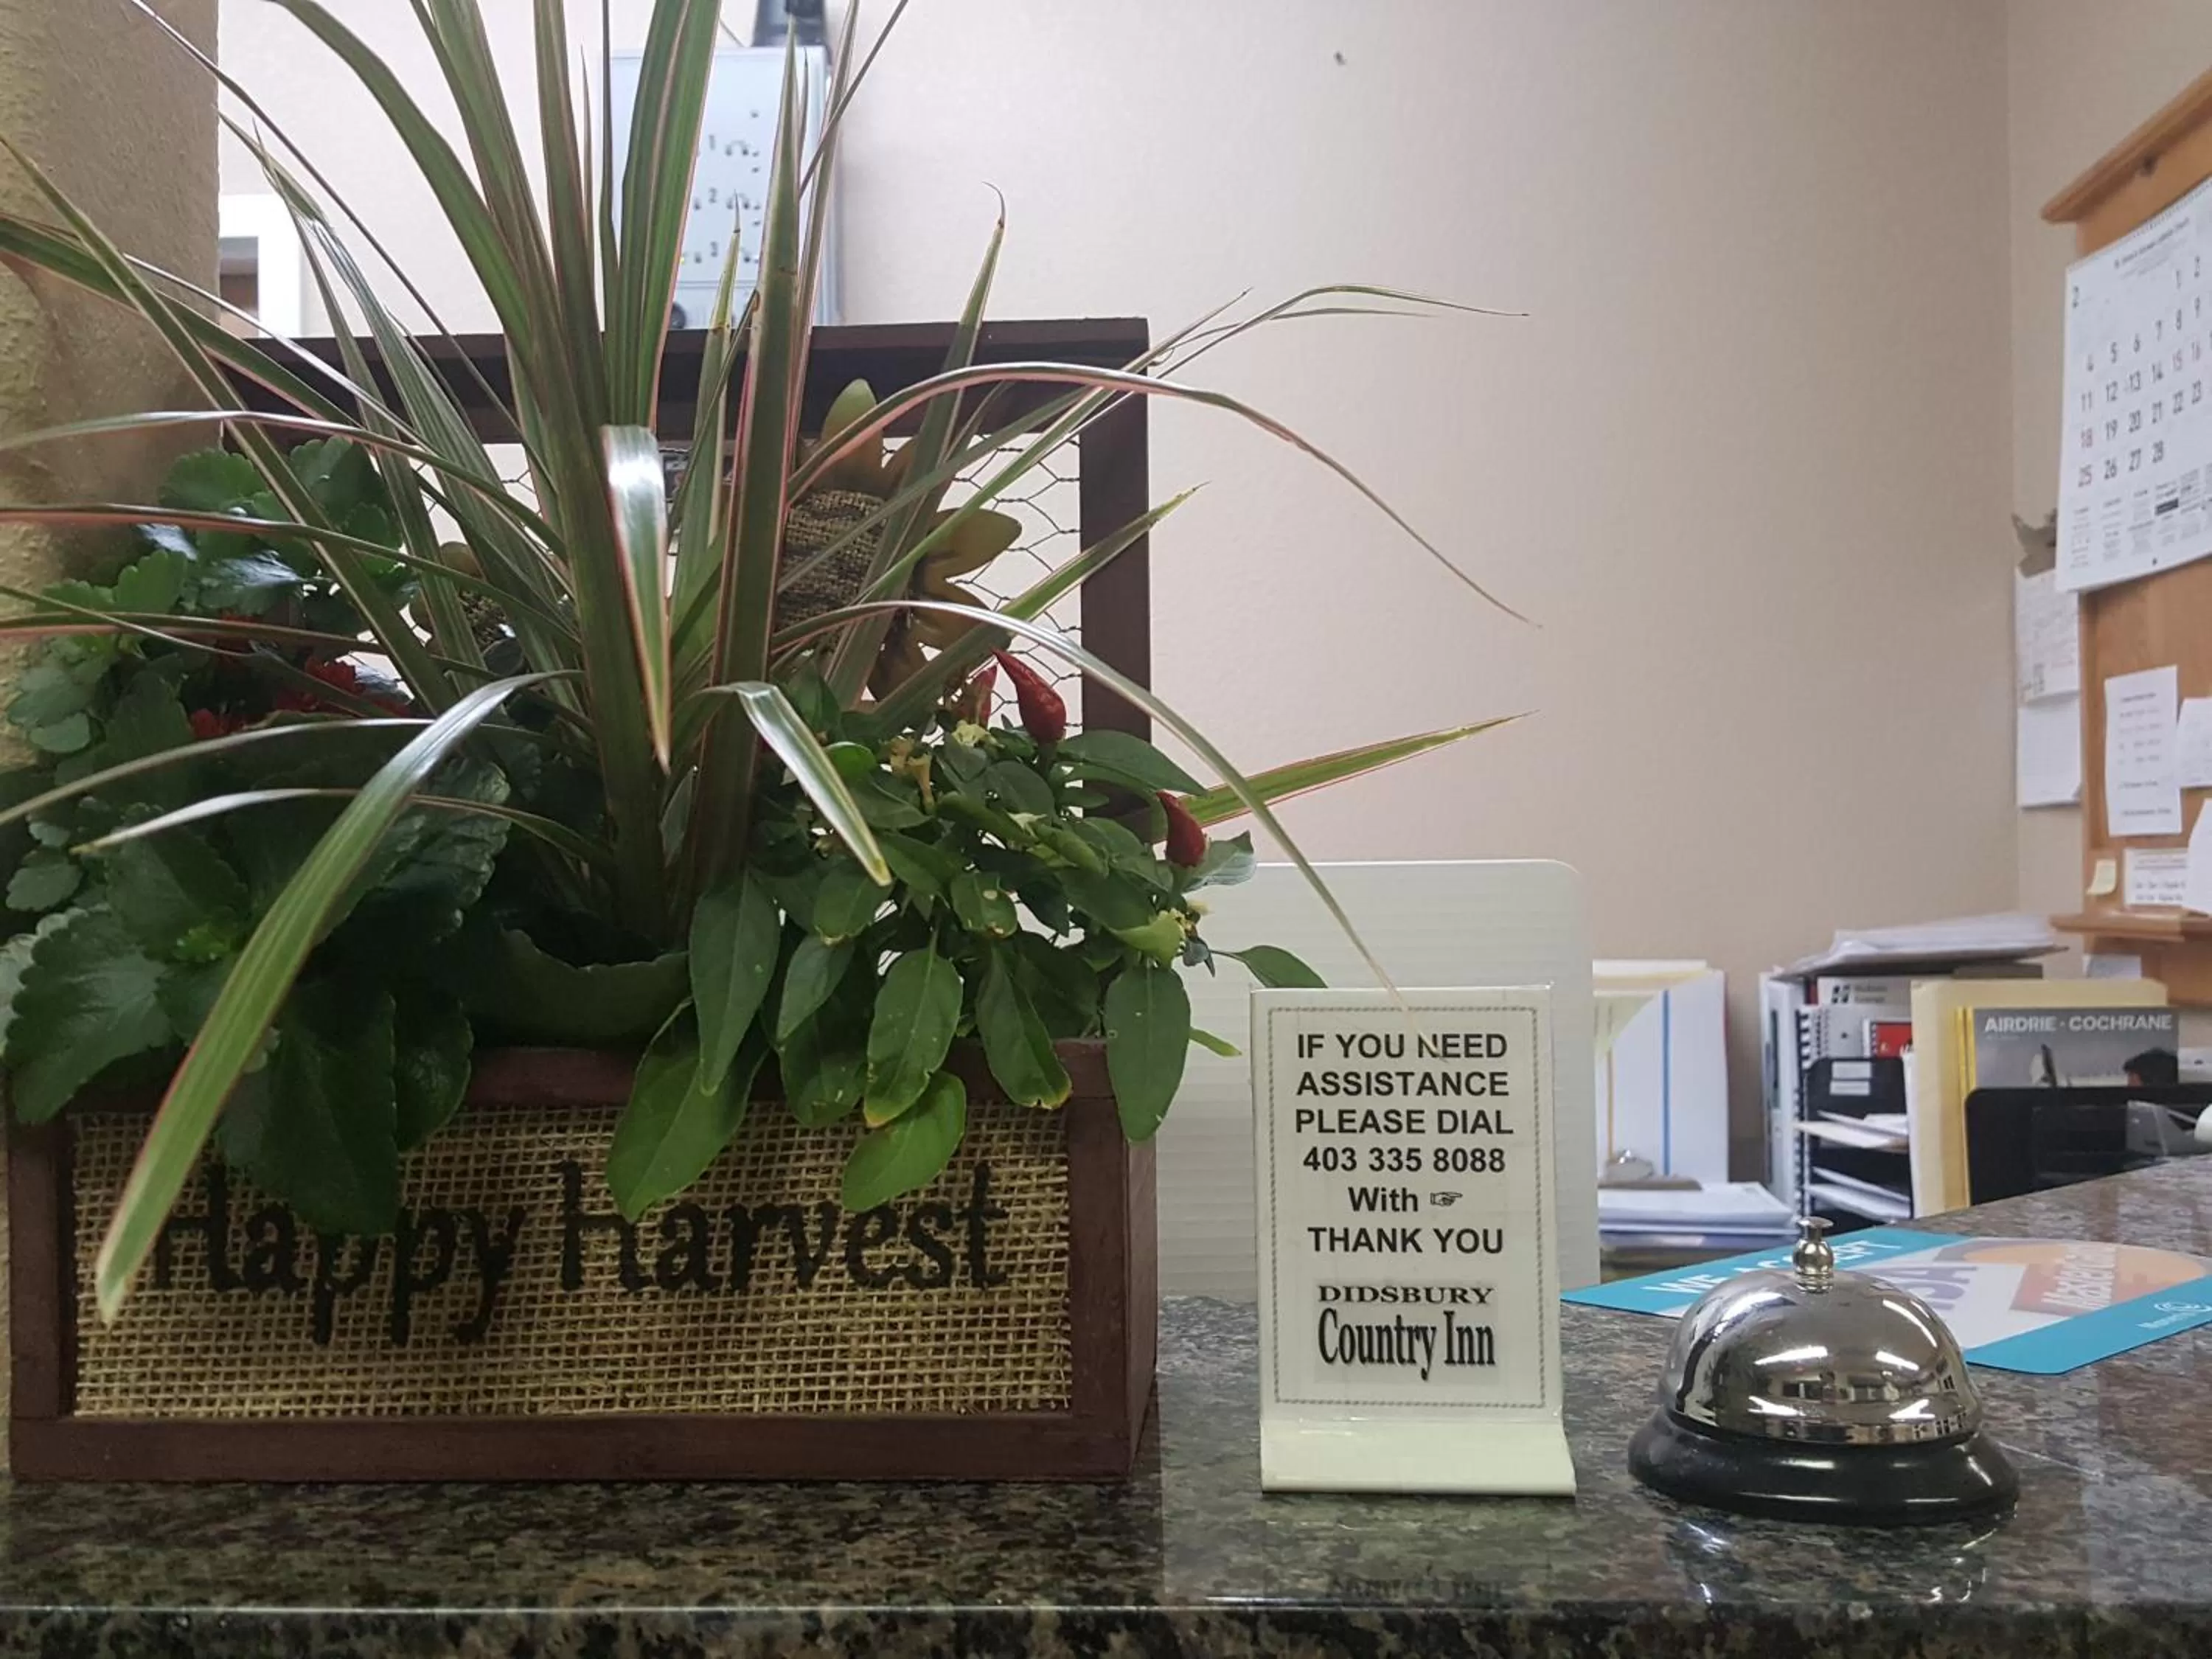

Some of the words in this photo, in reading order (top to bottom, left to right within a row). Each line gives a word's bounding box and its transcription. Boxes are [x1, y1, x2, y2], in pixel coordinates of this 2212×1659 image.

[2110, 341, 2118, 364] 5
[2134, 333, 2140, 354] 6
[2155, 319, 2163, 342] 7
[2176, 308, 2183, 331] 8
[2081, 390, 2093, 413] 11
[2106, 380, 2118, 403] 12
[2106, 418, 2118, 441] 19
[2078, 463, 2093, 488] 25
[2104, 457, 2118, 480] 26
[2129, 447, 2141, 472] 27
[2152, 439, 2164, 464] 28
[1984, 1015, 2057, 1033] AIRDRIE
[2068, 1013, 2174, 1032] COCHRANE
[1298, 1034, 1325, 1059] IF
[1335, 1033, 1405, 1059] YOU
[1417, 1033, 1508, 1059] NEED
[1296, 1071, 1509, 1096] ASSISTANCE
[1295, 1108, 1426, 1135] PLEASE
[1437, 1109, 1514, 1135] DIAL
[1303, 1146, 1357, 1172] 403
[1368, 1147, 1422, 1172] 335
[1433, 1147, 1506, 1173] 8088
[1347, 1186, 1419, 1213] With
[153, 1163, 527, 1346] Happy
[560, 1158, 1009, 1292] harvest
[1307, 1226, 1423, 1253] THANK
[1433, 1228, 1503, 1254] YOU
[1318, 1285, 1494, 1304] DIDSBURY
[1318, 1307, 1438, 1382] Country
[1443, 1310, 1496, 1367] Inn
